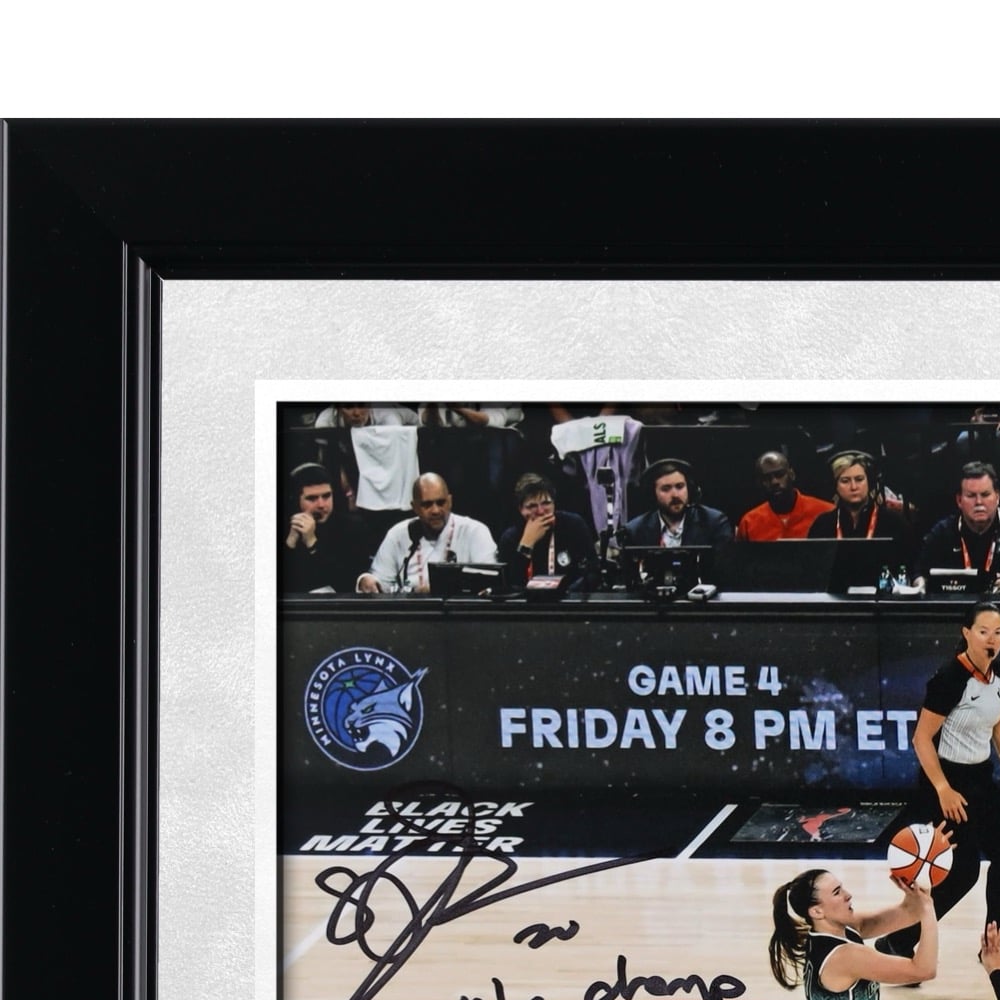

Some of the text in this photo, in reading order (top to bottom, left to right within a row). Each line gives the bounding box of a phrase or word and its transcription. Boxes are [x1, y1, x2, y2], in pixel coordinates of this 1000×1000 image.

[593, 422, 606, 443] ALS
[628, 664, 782, 696] GAME 4
[309, 653, 396, 746] MINNESOTA LYNX
[500, 708, 918, 751] FRIDAY 8 PM ET
[365, 801, 534, 817] BLACK
[359, 818, 503, 834] LIVES
